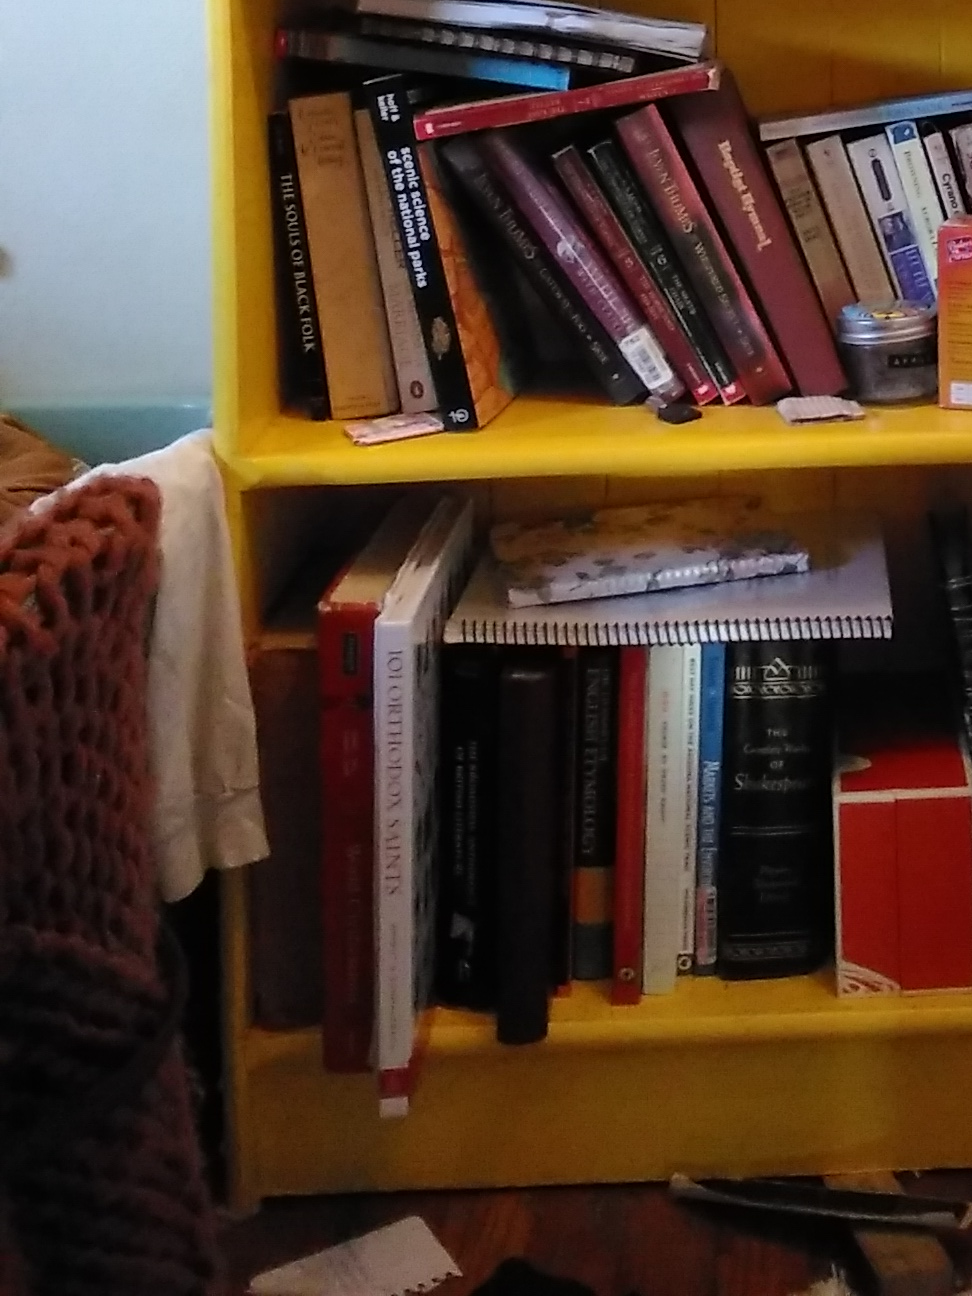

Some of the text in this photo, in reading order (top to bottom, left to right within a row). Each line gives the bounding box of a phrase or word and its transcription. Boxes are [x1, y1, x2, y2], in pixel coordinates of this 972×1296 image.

[385, 92, 399, 113] hoff
[386, 148, 429, 289] of the national parks
[399, 145, 432, 241] scenic science
[940, 173, 958, 208] Cyrano
[279, 173, 316, 353] THE SOULS OF BLACK FOLK
[385, 683, 403, 811] ORTHODOX
[383, 817, 401, 895] SAINTS
